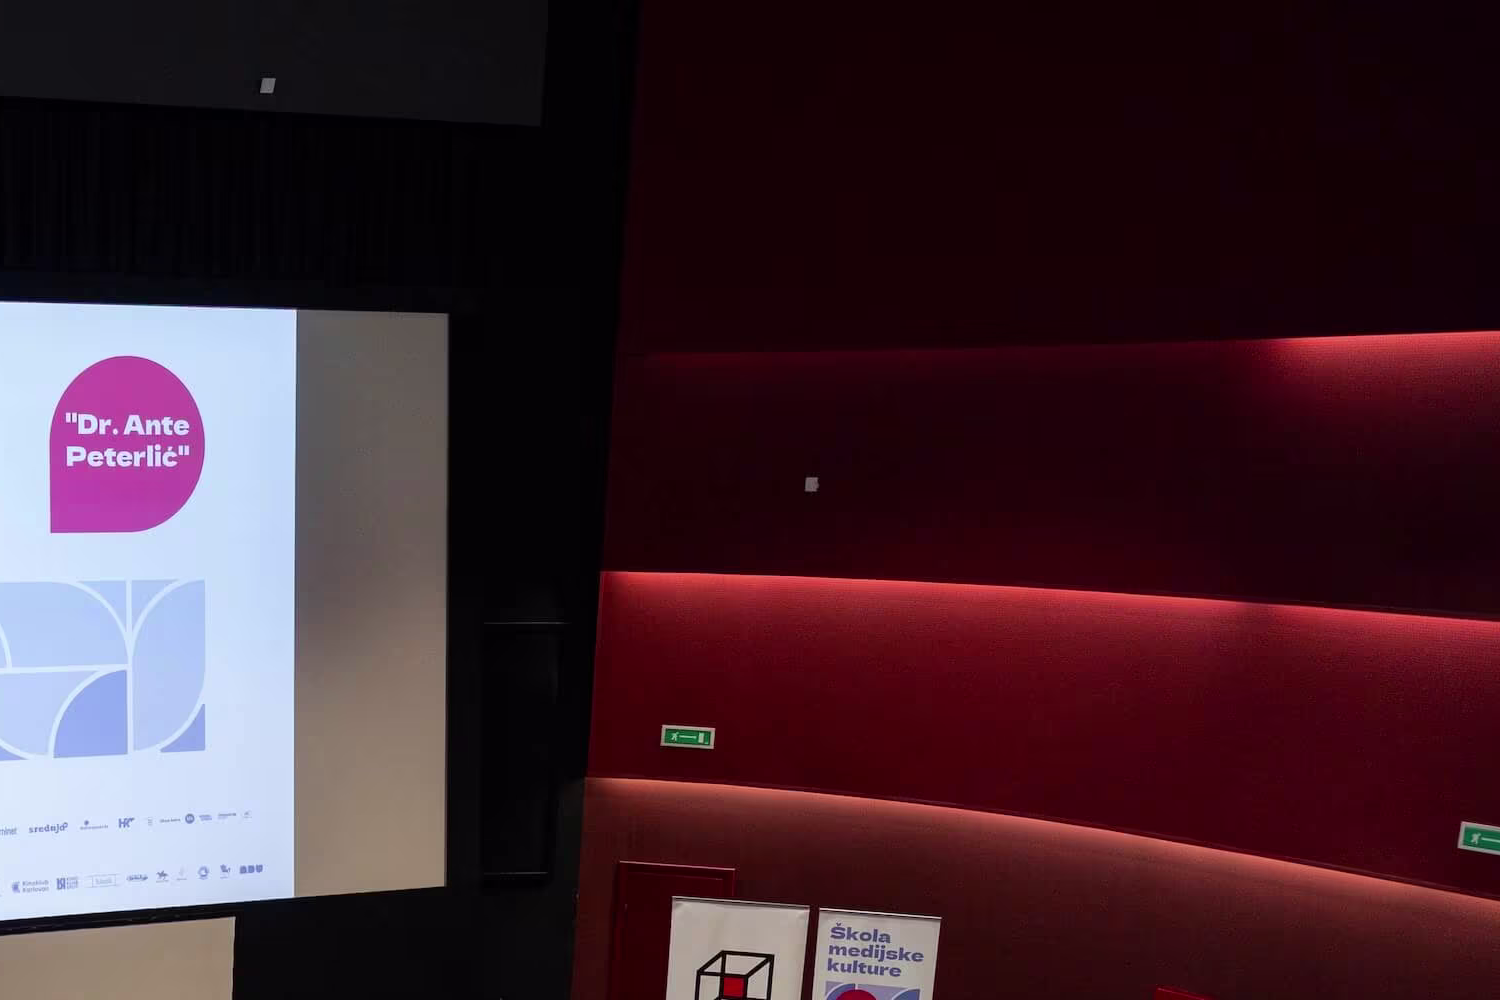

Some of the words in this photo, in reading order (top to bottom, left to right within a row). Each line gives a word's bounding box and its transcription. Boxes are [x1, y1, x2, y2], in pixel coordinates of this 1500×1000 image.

[65, 413, 118, 436] "Dr.
[123, 414, 190, 436] Ante
[66, 445, 190, 468] Peterlić"
[830, 922, 891, 944] Škola
[828, 944, 924, 962] medijske
[827, 958, 902, 977] kulture
